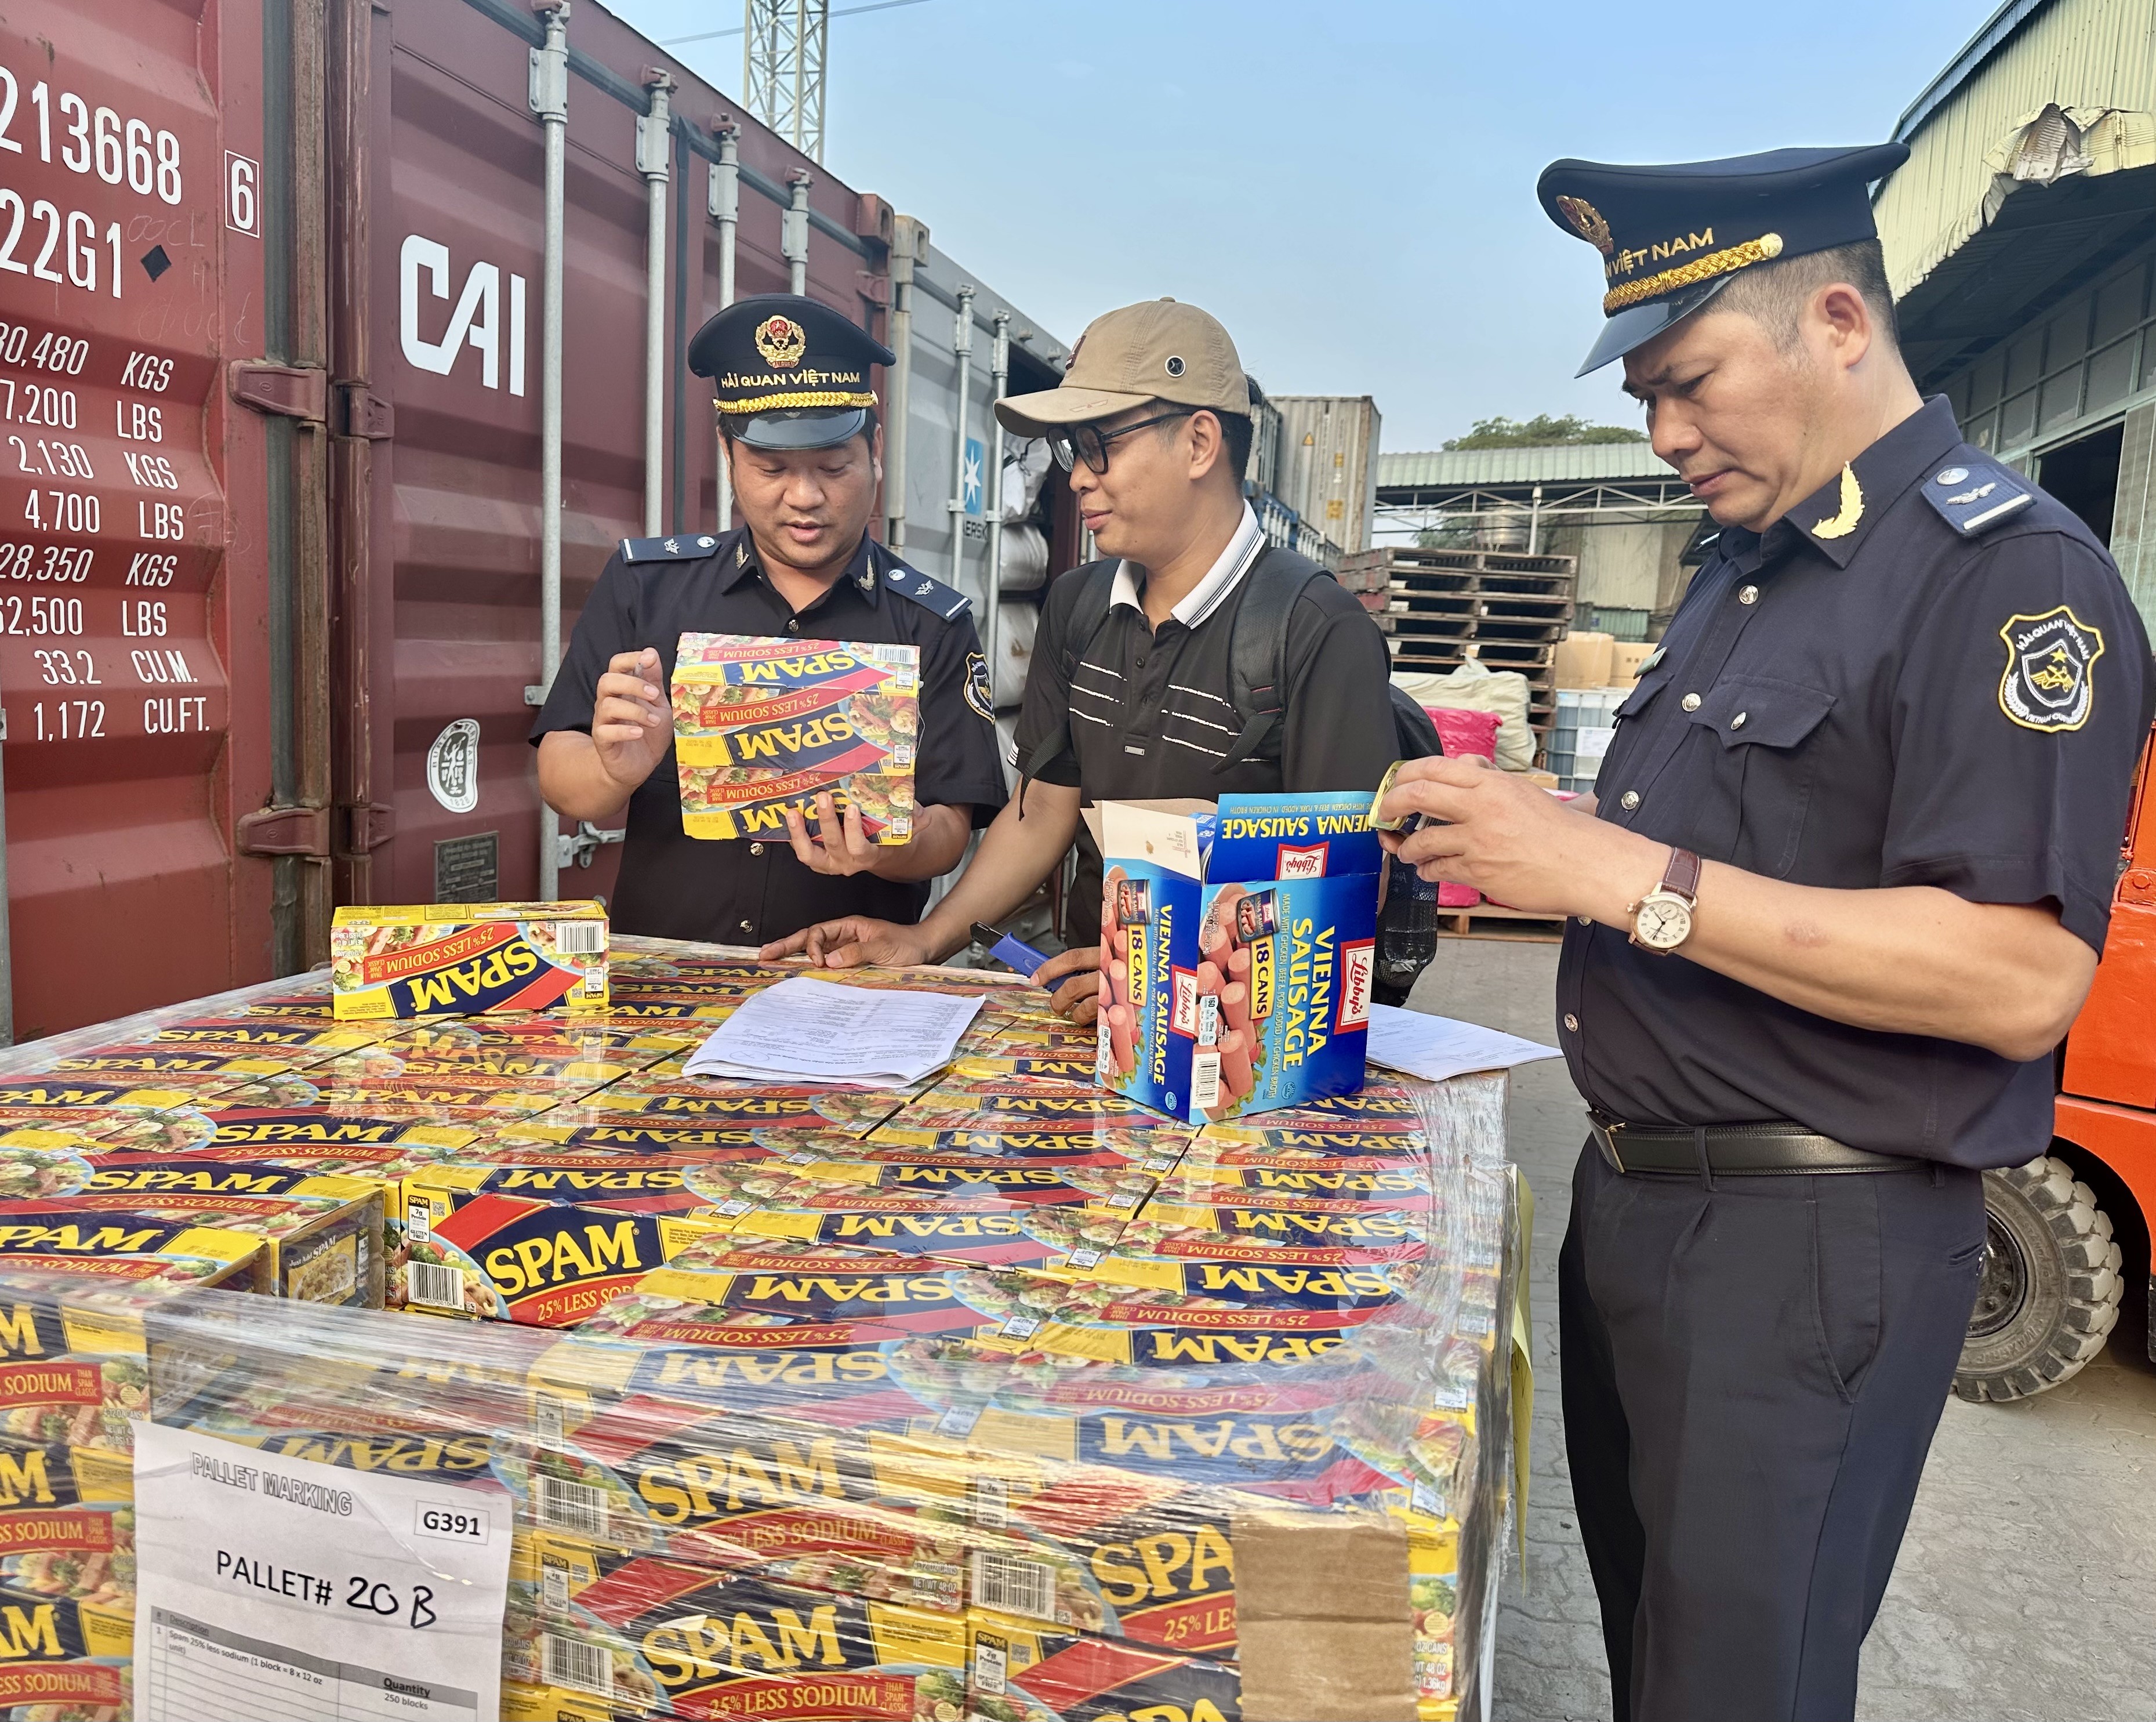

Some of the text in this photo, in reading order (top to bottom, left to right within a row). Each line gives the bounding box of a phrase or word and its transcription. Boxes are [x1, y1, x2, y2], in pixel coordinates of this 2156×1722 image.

[231, 158, 254, 230] 6
[0, 188, 122, 299] 22G1
[1652, 227, 1714, 261] NAM
[401, 234, 526, 397] CAI
[121, 351, 174, 392] KGS
[743, 373, 786, 387] QUAN
[832, 372, 860, 383] NAM
[117, 400, 162, 443] LBS
[9, 436, 179, 490] 2,130 KGS
[25, 489, 100, 533] 4,700
[139, 501, 184, 540] LBS
[0, 543, 177, 587] 28,350 KGS
[122, 600, 167, 637] LBS
[34, 650, 198, 684] 33.2 CU.M.
[739, 651, 856, 683] SPAM
[34, 697, 210, 742] 1,172 CU.FT.
[720, 692, 819, 722] 25% LESS SODIUM
[735, 713, 854, 760] SPAM
[1222, 815, 1380, 839] IENNA SAUSAGE
[1284, 854, 1321, 873] Libby's
[1282, 894, 1290, 914] MADE
[1280, 916, 1289, 934] WITH
[386, 926, 495, 973] 25% LESS SODIUM
[1256, 941, 1269, 963] 18
[408, 942, 537, 1012] SPAM
[676, 965, 800, 978] SPAM
[1131, 929, 1143, 1001] 18 CANS
[1278, 968, 1286, 984] BEEF
[620, 984, 743, 995] SPAM
[1153, 904, 1173, 1085] VIENNA SAUSAGE
[1256, 967, 1269, 1014] CANS
[1283, 918, 1313, 1072] SAUSAGE
[1306, 926, 1335, 1057] VIENNA
[1351, 952, 1365, 1016] Libby's
[1178, 981, 1193, 1025] Libby's
[1207, 997, 1215, 1007] 160
[1276, 992, 1285, 1009] PORK
[155, 1029, 306, 1043] SPAM
[54, 1057, 216, 1072] SPAM
[1271, 1047, 1281, 1075] CHICKEN
[1269, 1077, 1280, 1099] BROTH
[215, 1123, 393, 1142] SPAM
[589, 1128, 754, 1144] SPAM
[952, 1131, 1103, 1150] SPAM
[222, 1147, 376, 1160] 25% LESS SODIUM
[84, 1171, 281, 1192] SPAM
[507, 1170, 684, 1188] SPAM
[896, 1167, 1063, 1184] SPAM
[87, 1197, 263, 1211] 25% LESS SODIUM
[409, 1197, 429, 1205] SPAM
[840, 1215, 1022, 1237] SPAM
[1238, 1210, 1406, 1237] SPAM
[302, 1252, 313, 1263] Add
[313, 1235, 336, 1260] SPAM
[486, 1220, 642, 1297] SPAM
[1188, 1246, 1344, 1262] 25% LESS SODIUM
[749, 1256, 922, 1271] 25% LESS SODIUM
[750, 1277, 954, 1303] SPAM
[1204, 1265, 1391, 1295] SPAM
[1137, 1309, 1311, 1326] 25% LESS SODIUM
[666, 1327, 856, 1343] 25% LESS SODIUM
[5, 1372, 72, 1394] SODIUM
[77, 1369, 93, 1378] THAN
[1103, 1418, 1334, 1461] SPAM
[192, 1452, 353, 1517] PALLET MARKING
[637, 1436, 847, 1524] SPAM
[17, 1520, 84, 1541] SODIUM
[423, 1510, 481, 1537] G391
[217, 1550, 333, 1607] PALLET#
[1091, 1524, 1235, 1606] SPA
[410, 1585, 437, 1629] B
[157, 1627, 161, 1635] 1
[169, 1630, 189, 1645] Spam
[190, 1636, 205, 1650] 25%
[206, 1641, 220, 1654] less
[221, 1644, 249, 1663] sodium
[260, 1659, 281, 1673] block
[289, 1668, 295, 1676] 8
[303, 1672, 312, 1681] 12
[313, 1677, 322, 1685] oz
[643, 1605, 847, 1686] SPAM
[26, 1673, 92, 1694] SODIUM
[383, 1677, 431, 1699] Quantity
[884, 1682, 904, 1692] THAN
[384, 1693, 429, 1711] 250 blocks
[710, 1685, 878, 1721] 25% LESS SODIUM
[881, 1702, 908, 1713] CLASSIC
